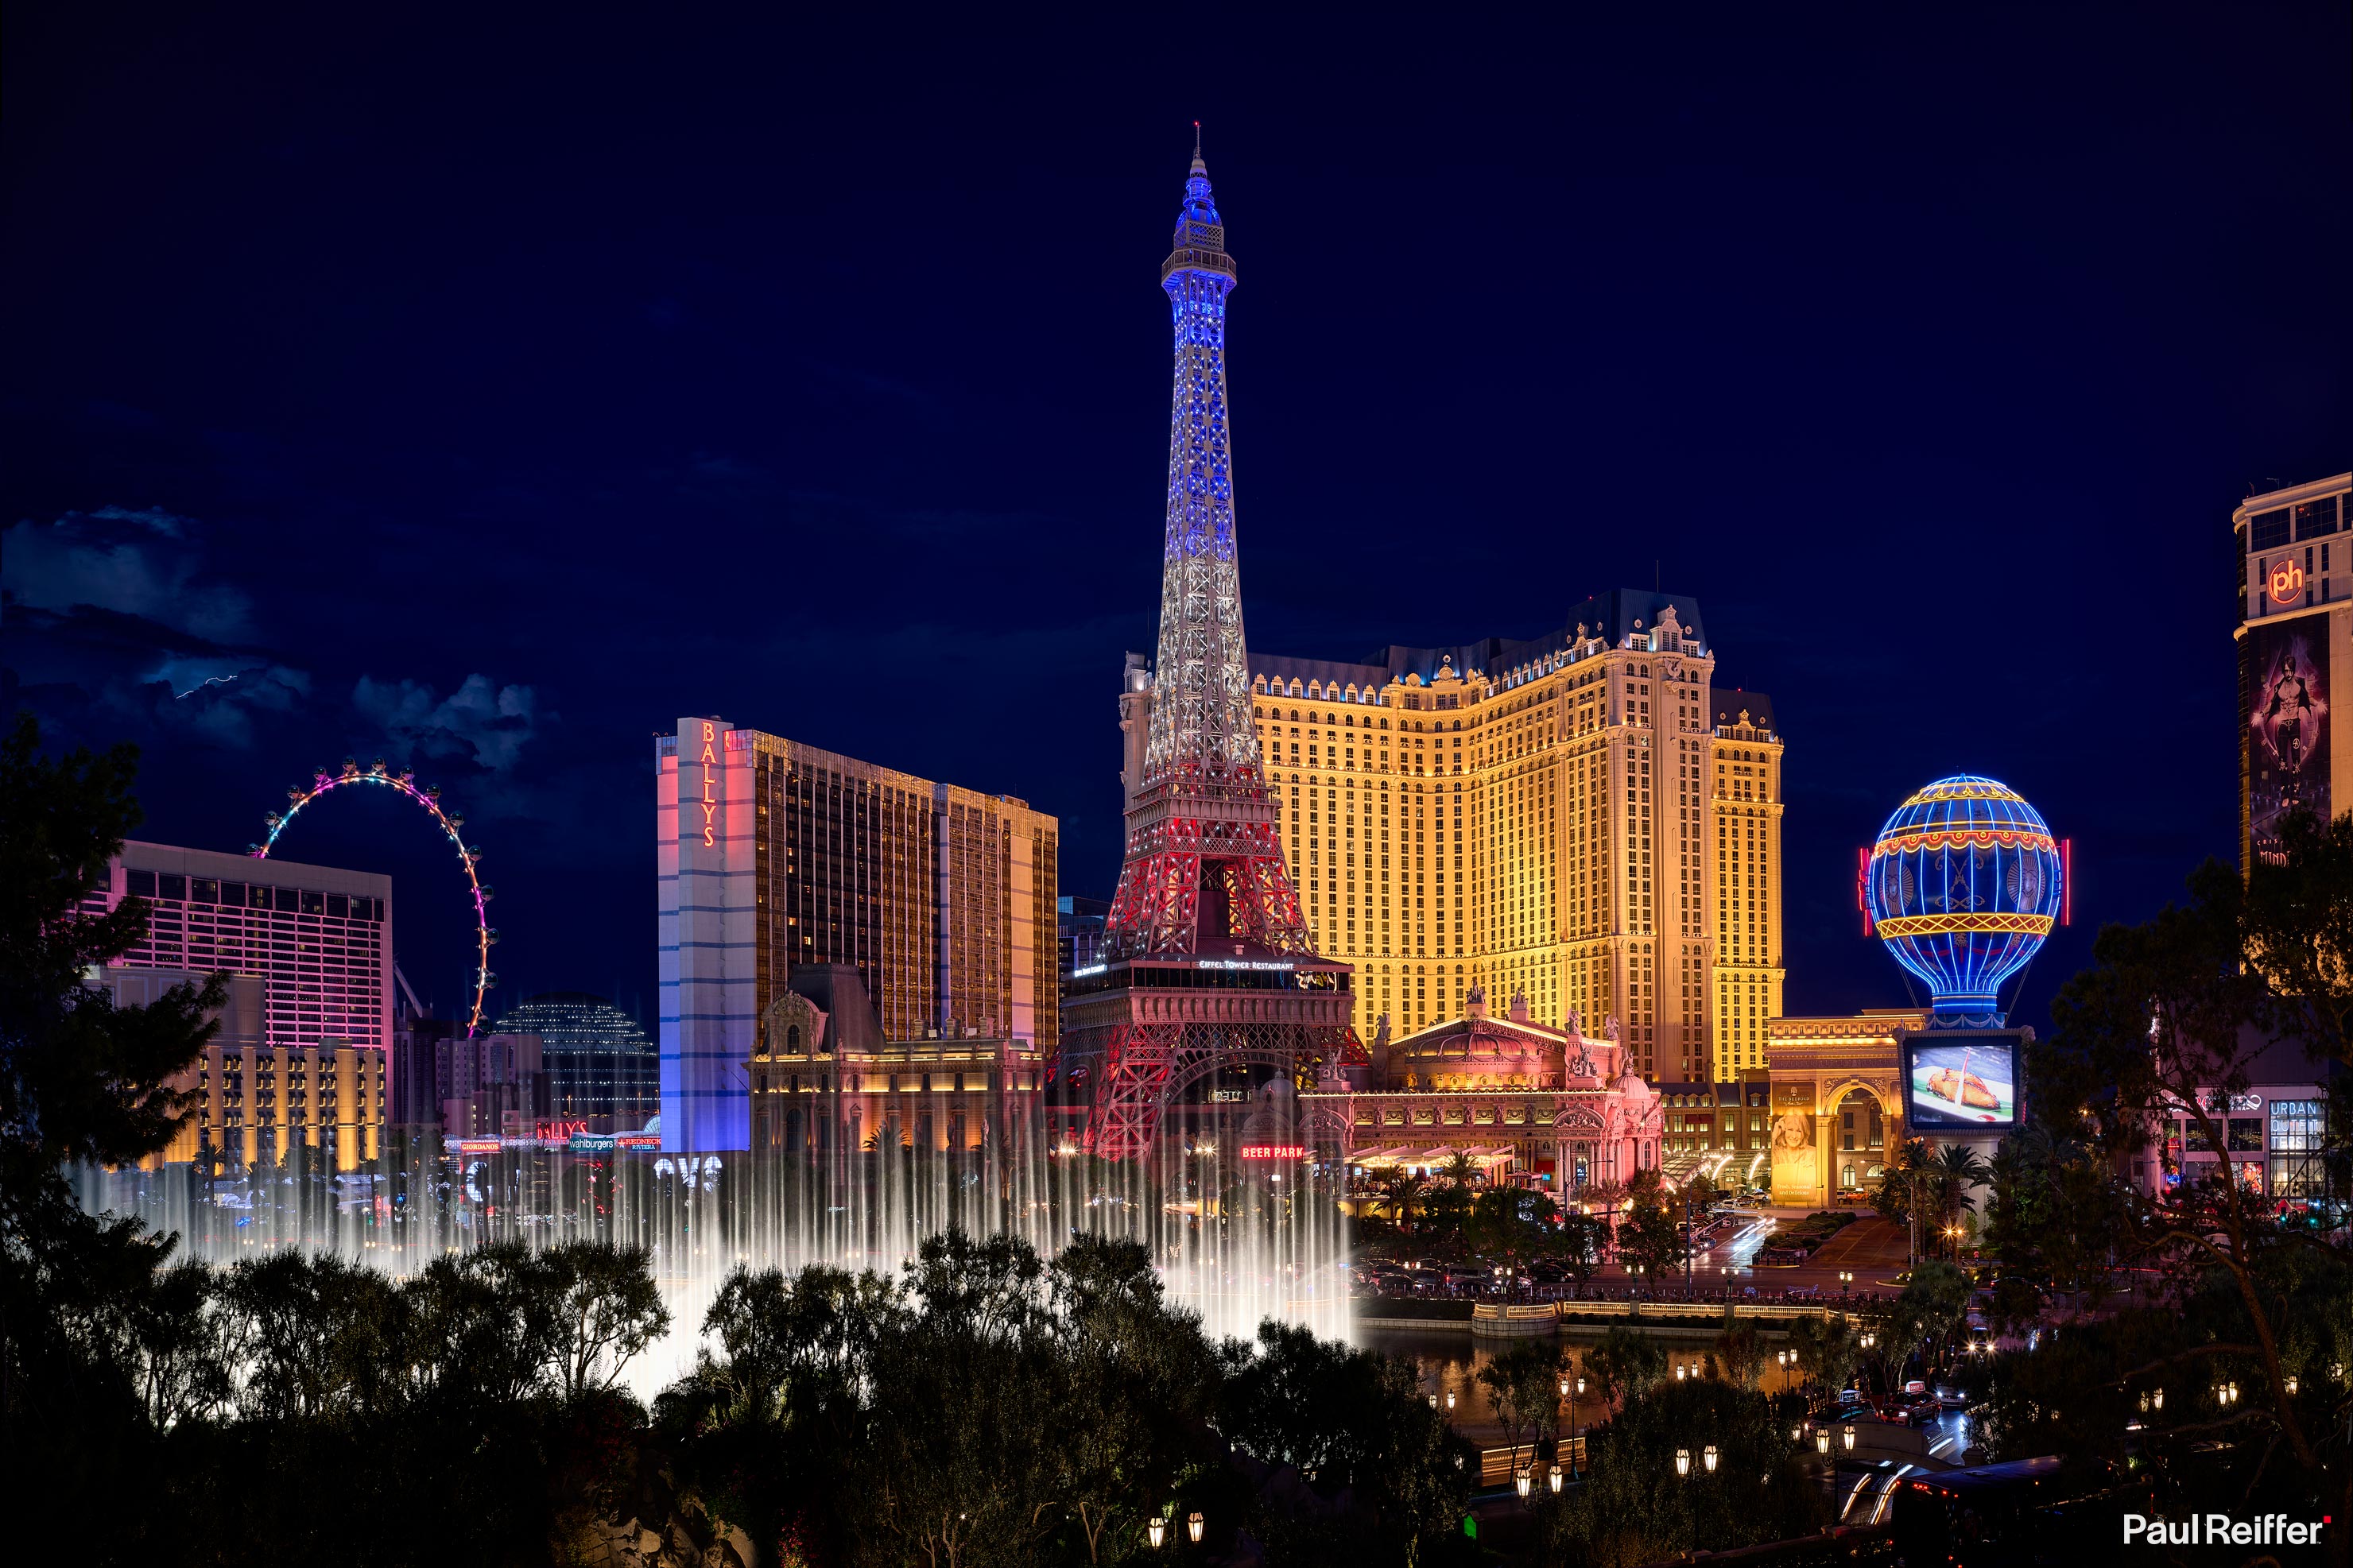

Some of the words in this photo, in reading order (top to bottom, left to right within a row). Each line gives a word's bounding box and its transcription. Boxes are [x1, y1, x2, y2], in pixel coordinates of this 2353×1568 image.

[2273, 559, 2303, 598] ph
[700, 722, 716, 847] BALLYS
[1199, 960, 1223, 969] EIFFEL
[1224, 960, 1250, 969] TOWER
[2270, 1102, 2316, 1115] URBAN
[2270, 1119, 2319, 1132] OUTFIT
[569, 1138, 614, 1151] wahlburgers
[2271, 1136, 2303, 1150] TERS
[1242, 1147, 1271, 1158] BEER
[1274, 1147, 1304, 1158] PARK
